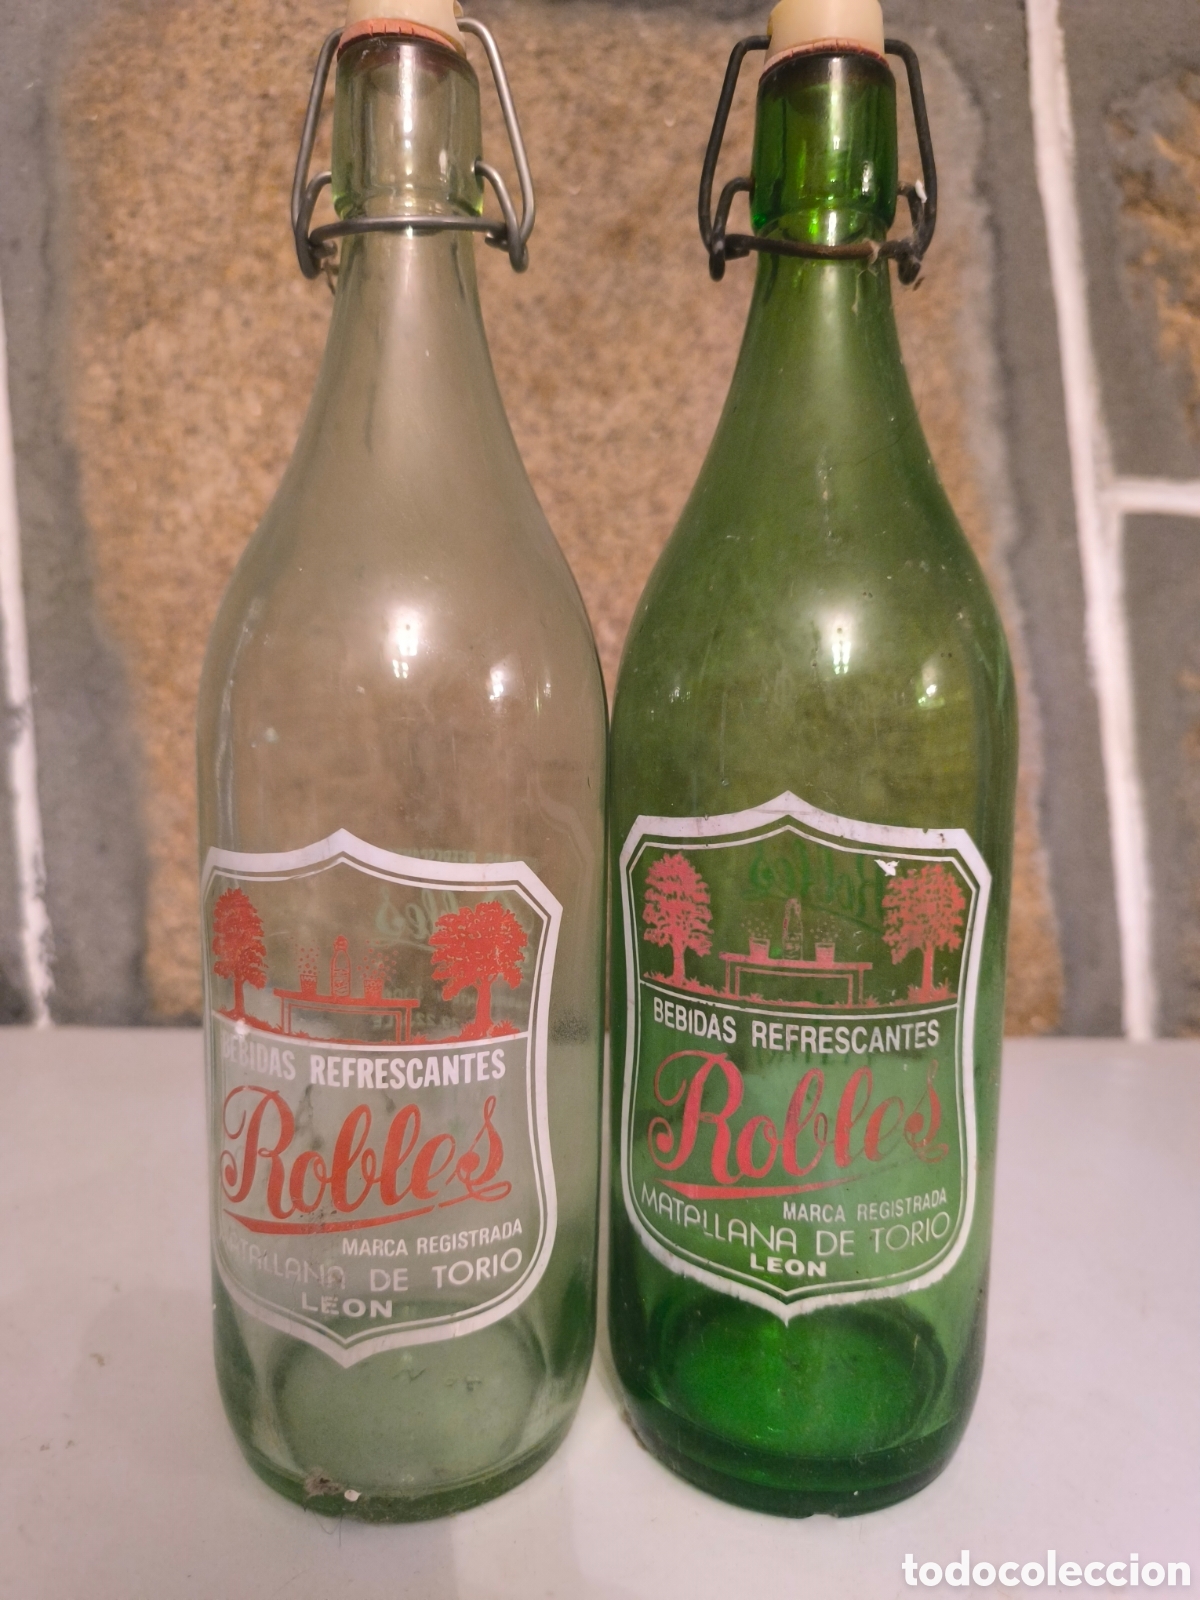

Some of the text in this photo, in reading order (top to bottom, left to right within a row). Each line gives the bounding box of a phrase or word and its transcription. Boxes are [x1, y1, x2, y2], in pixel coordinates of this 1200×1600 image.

[653, 997, 940, 1054] BEBIDAS REFRESCANTES
[221, 1030, 506, 1090] BEBIDAS REFRESCANTES
[648, 1050, 949, 1185] Robles
[220, 1085, 512, 1220] Robles
[641, 1181, 951, 1257] MATALLANA DE TORIO
[783, 1187, 947, 1223] MARCA REGISTRADA
[221, 1229, 522, 1292] ATALLANA DE TORIO
[342, 1218, 522, 1257] MARCA REGISTRADA
[750, 1253, 827, 1277] LEON
[301, 1292, 393, 1318] LEON
